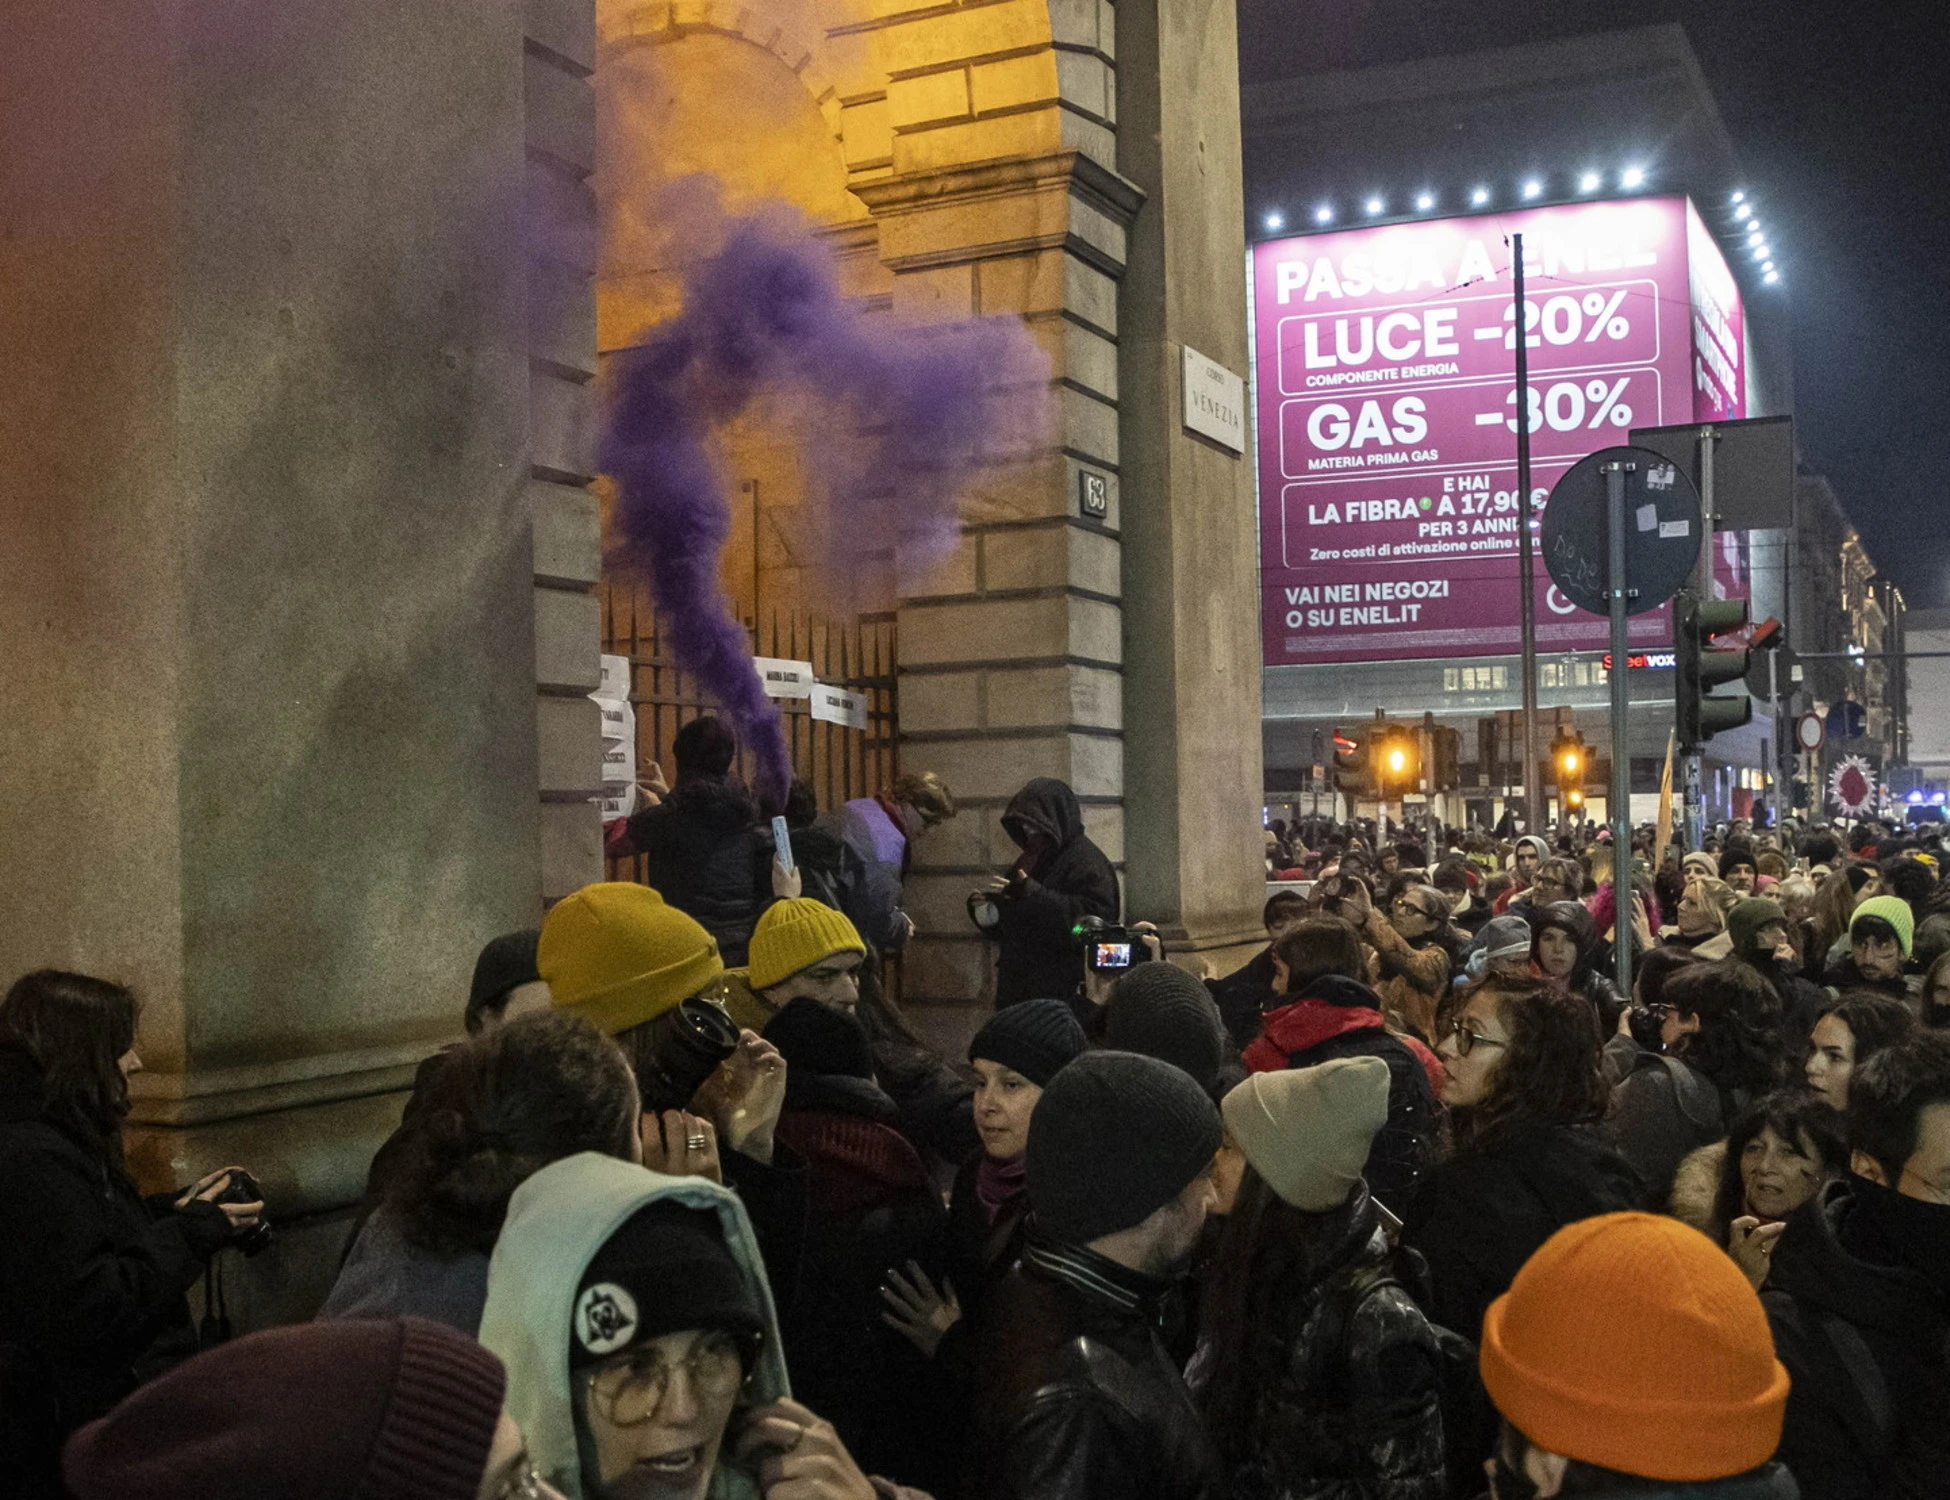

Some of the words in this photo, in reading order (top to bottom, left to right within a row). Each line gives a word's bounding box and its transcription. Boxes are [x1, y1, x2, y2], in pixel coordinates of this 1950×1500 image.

[1276, 241, 1447, 304] PASSA
[1455, 239, 1497, 284] A
[1508, 223, 1658, 280] ENEL
[1304, 308, 1460, 370] LUCE
[1473, 290, 1630, 350] -20%
[1205, 367, 1226, 385] CORSO
[1306, 368, 1400, 387] COMPONENTE
[1401, 362, 1460, 379] ENERGIA
[1193, 390, 1239, 429] VENEZIA
[1307, 396, 1428, 451] GAS
[1475, 377, 1633, 434] -30%
[1308, 455, 1365, 470] MATERIA
[1366, 451, 1409, 466] PRIMA
[1411, 449, 1439, 462] GAS
[1088, 477, 1105, 510] 63
[1443, 477, 1455, 493] E
[1458, 475, 1490, 492] HAI
[1308, 503, 1341, 525] LA
[1345, 497, 1421, 523] FIBRA
[1436, 494, 1456, 516] A
[1418, 521, 1453, 538] PER
[1456, 520, 1469, 536] 3
[1471, 516, 1518, 534] ANNI
[1309, 547, 1340, 560] Zero
[1341, 543, 1376, 559] costi
[1377, 542, 1391, 556] di
[1392, 540, 1468, 556] attivazione
[1470, 536, 1513, 551] online
[1285, 586, 1321, 605] VAI
[1324, 584, 1361, 604] NEI
[1365, 579, 1449, 600] NEGOZI
[1286, 610, 1303, 629] O
[1307, 608, 1335, 627] SU
[1339, 604, 1422, 626] ENEL.IT
[1603, 653, 1676, 670] Seetvox
